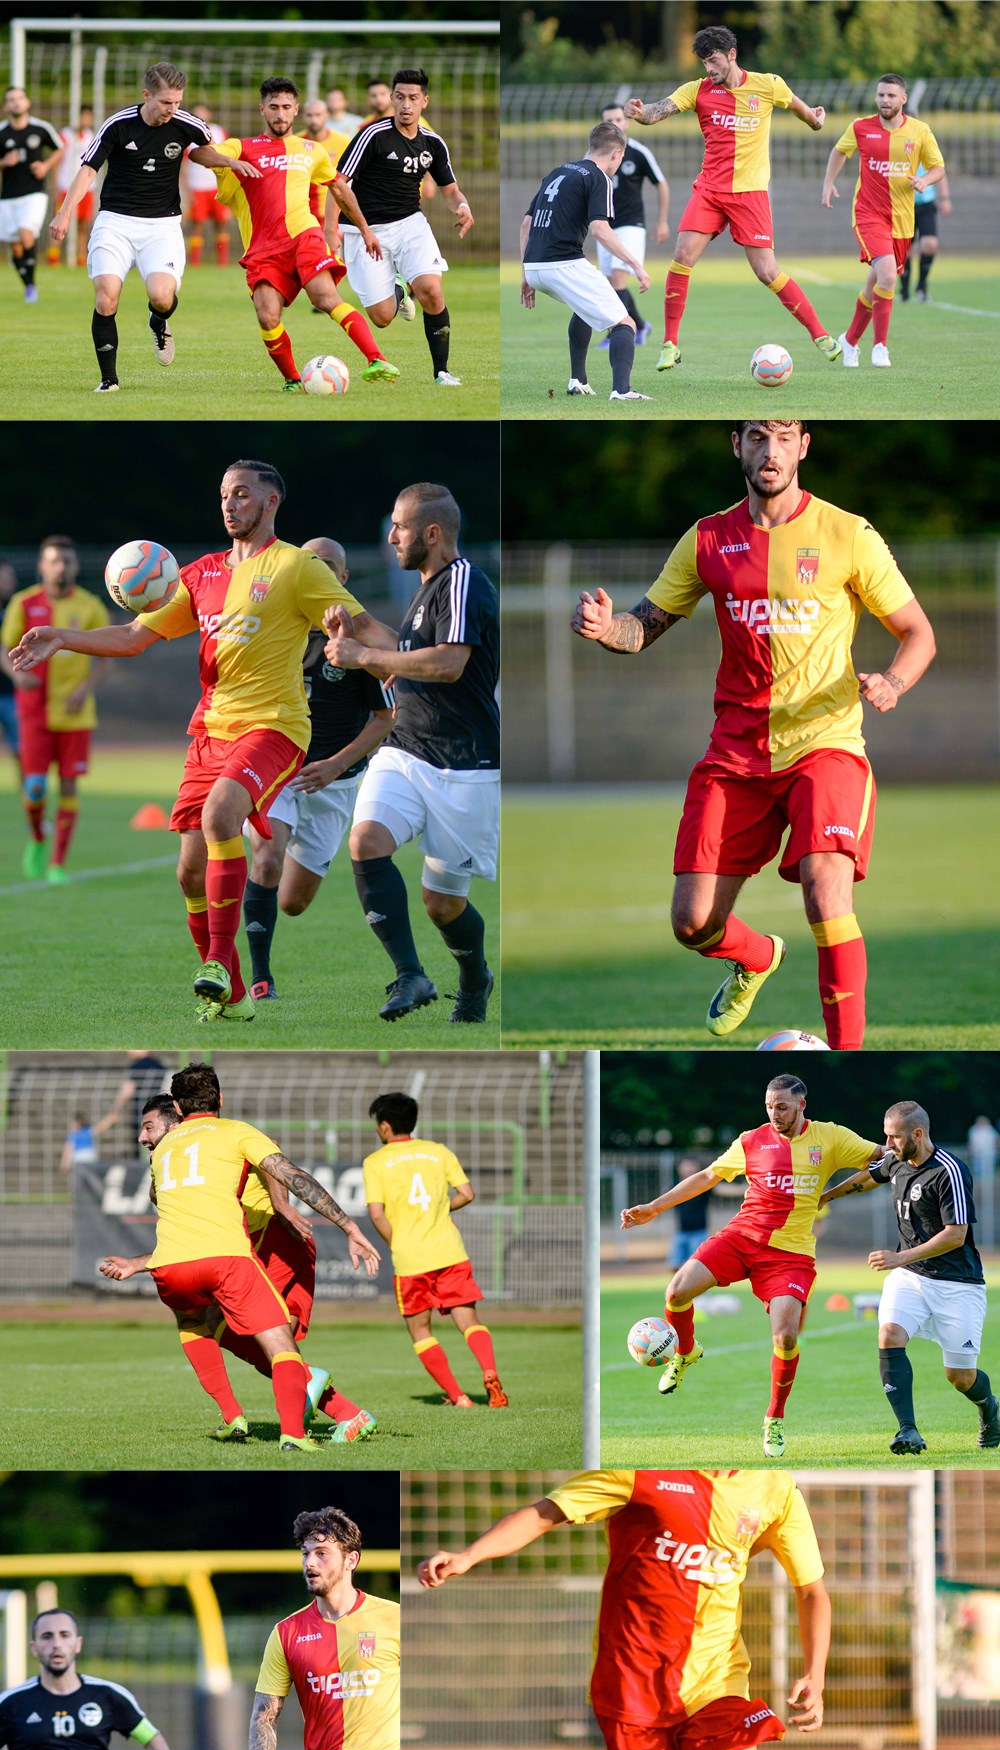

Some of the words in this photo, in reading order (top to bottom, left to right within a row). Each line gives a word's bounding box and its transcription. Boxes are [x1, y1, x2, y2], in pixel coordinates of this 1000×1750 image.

[711, 111, 760, 129] tipico
[143, 158, 156, 172] 4
[258, 154, 313, 171] tipico
[403, 156, 418, 173] 21
[868, 157, 911, 173] tipico
[544, 175, 566, 203] 4
[719, 542, 751, 554] Joma
[725, 593, 820, 627] tipico
[824, 826, 855, 839] Joma
[760, 1142, 780, 1151] Joma
[159, 1142, 205, 1191] 11
[765, 1171, 820, 1188] tipico
[407, 1172, 431, 1211] 4
[896, 1199, 910, 1220] 17
[651, 1331, 675, 1358] DERBYSTAR
[344, 1412, 372, 1441] NIKE
[657, 1480, 694, 1494] Joma
[296, 1631, 322, 1644] Joma
[307, 1670, 381, 1695] tipico
